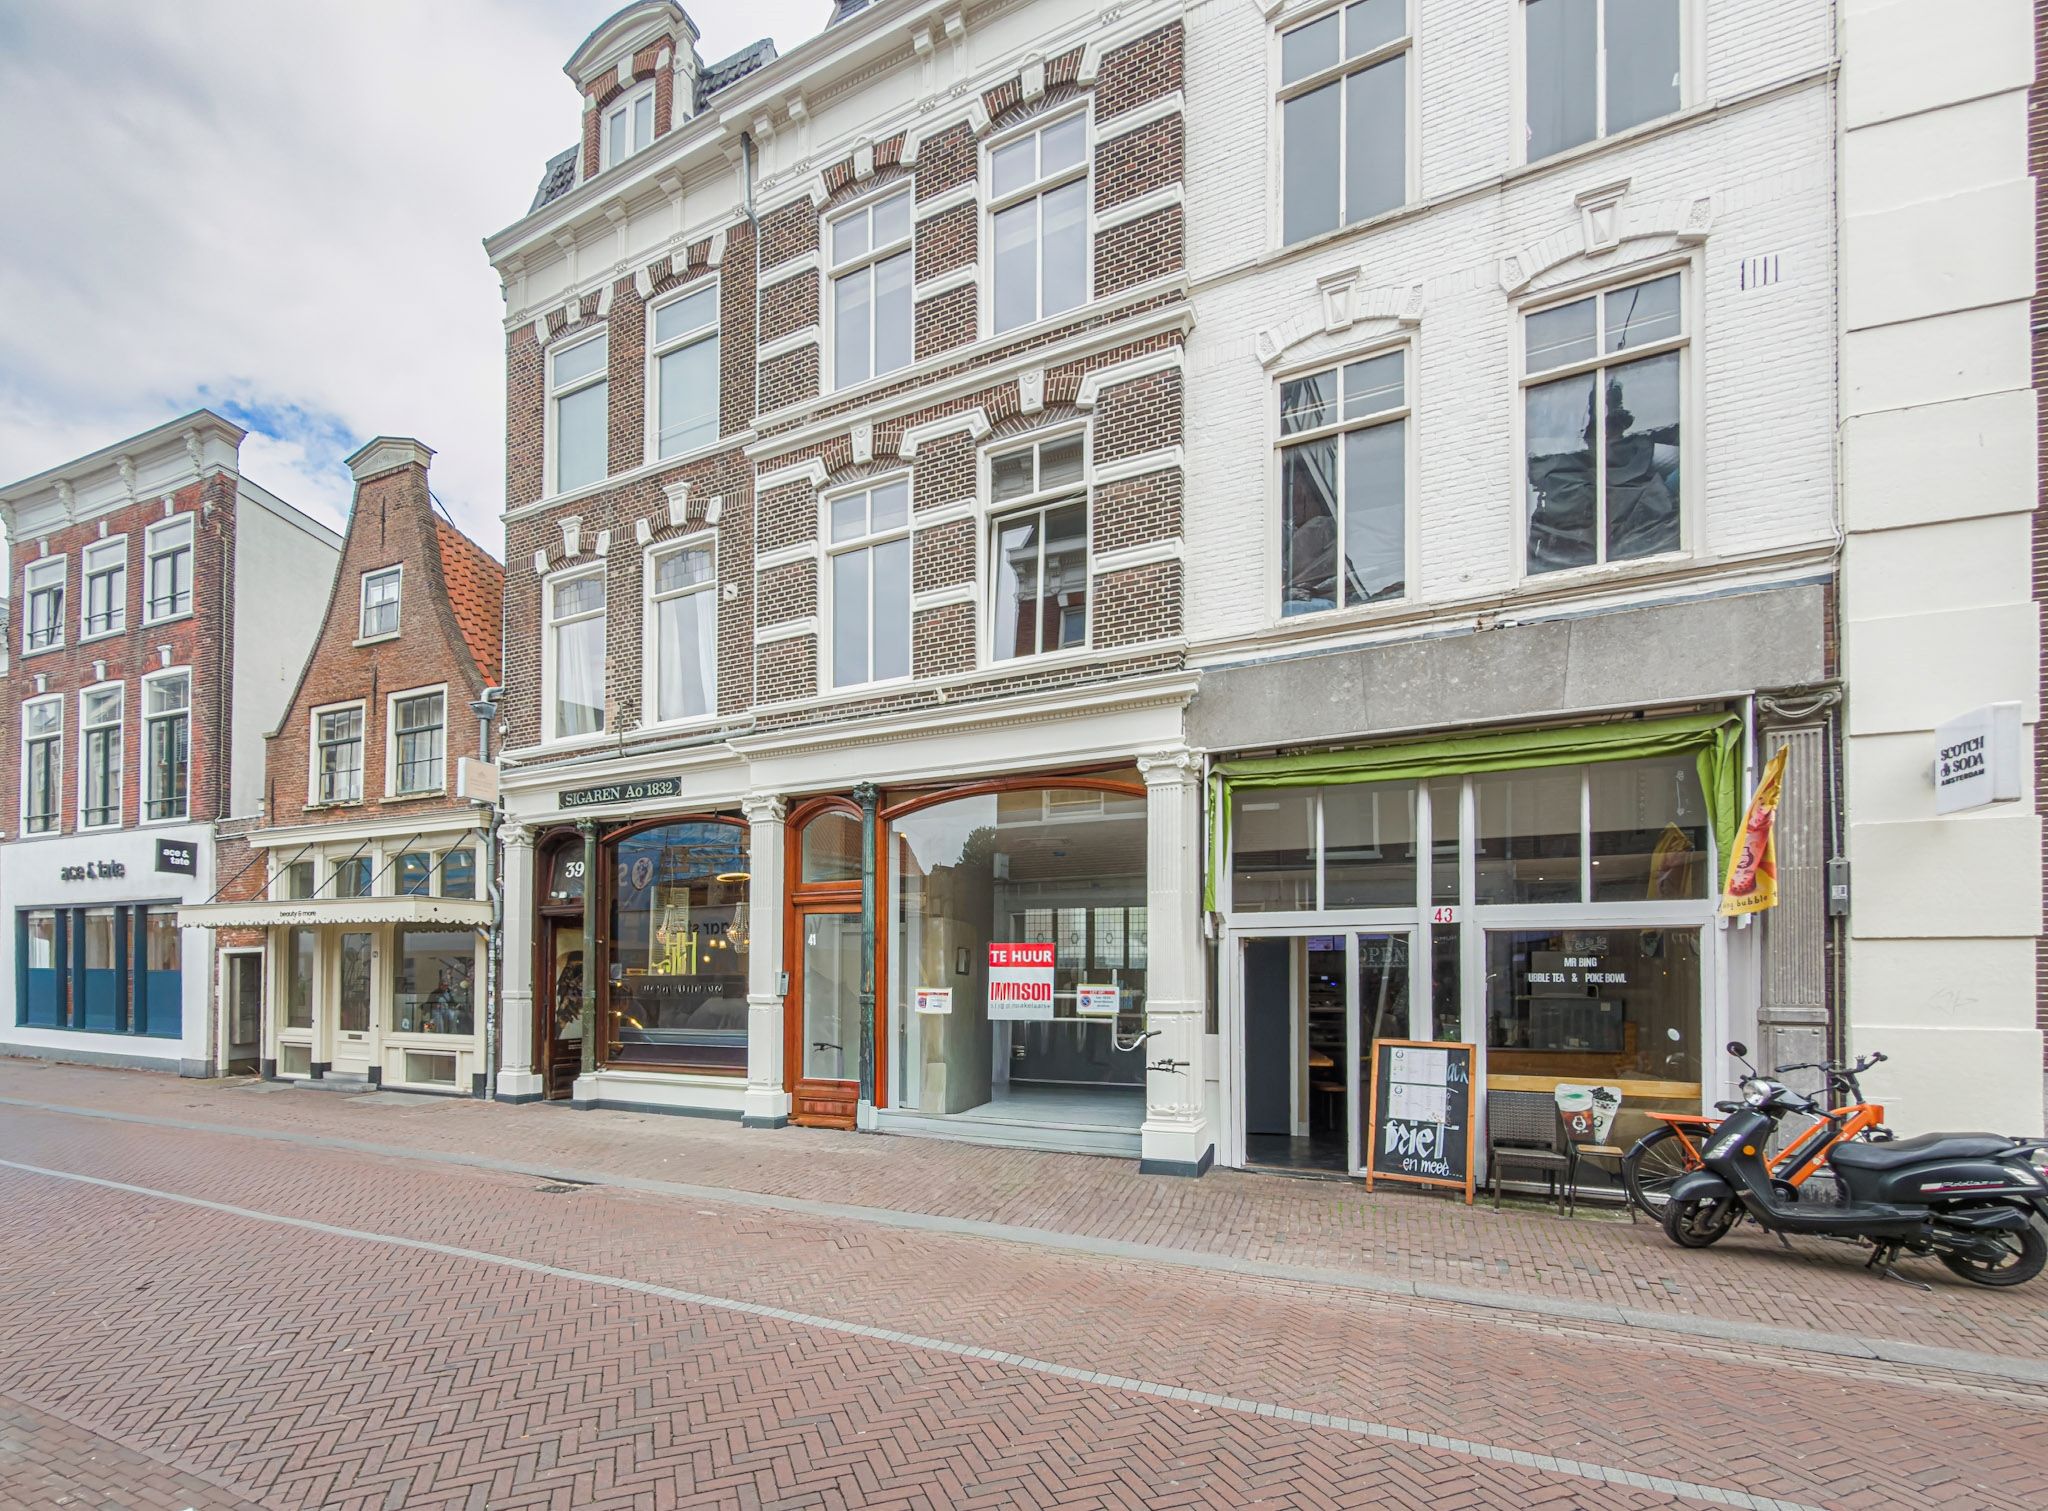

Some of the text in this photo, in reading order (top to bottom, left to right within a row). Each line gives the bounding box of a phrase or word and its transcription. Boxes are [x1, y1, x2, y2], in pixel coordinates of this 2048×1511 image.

[1940, 735, 1984, 761] SCOTCH
[1940, 752, 1984, 777] & SODA
[1941, 768, 1985, 786] AMSTERDAM
[565, 781, 673, 805] SIGAREN Ao 1832
[163, 848, 190, 858] ace &
[170, 856, 190, 866] tate
[61, 860, 125, 880] ace & tate
[565, 861, 585, 878] 39
[1736, 895, 1768, 907] bubble
[279, 910, 297, 918] beauty
[1434, 907, 1453, 922] 43
[808, 933, 816, 946] 41
[991, 950, 1052, 963] TE HUUR
[1563, 957, 1597, 968] MR BING
[1527, 973, 1627, 984] UBBLE TEA & POKE BOWL
[1402, 1157, 1417, 1171] en
